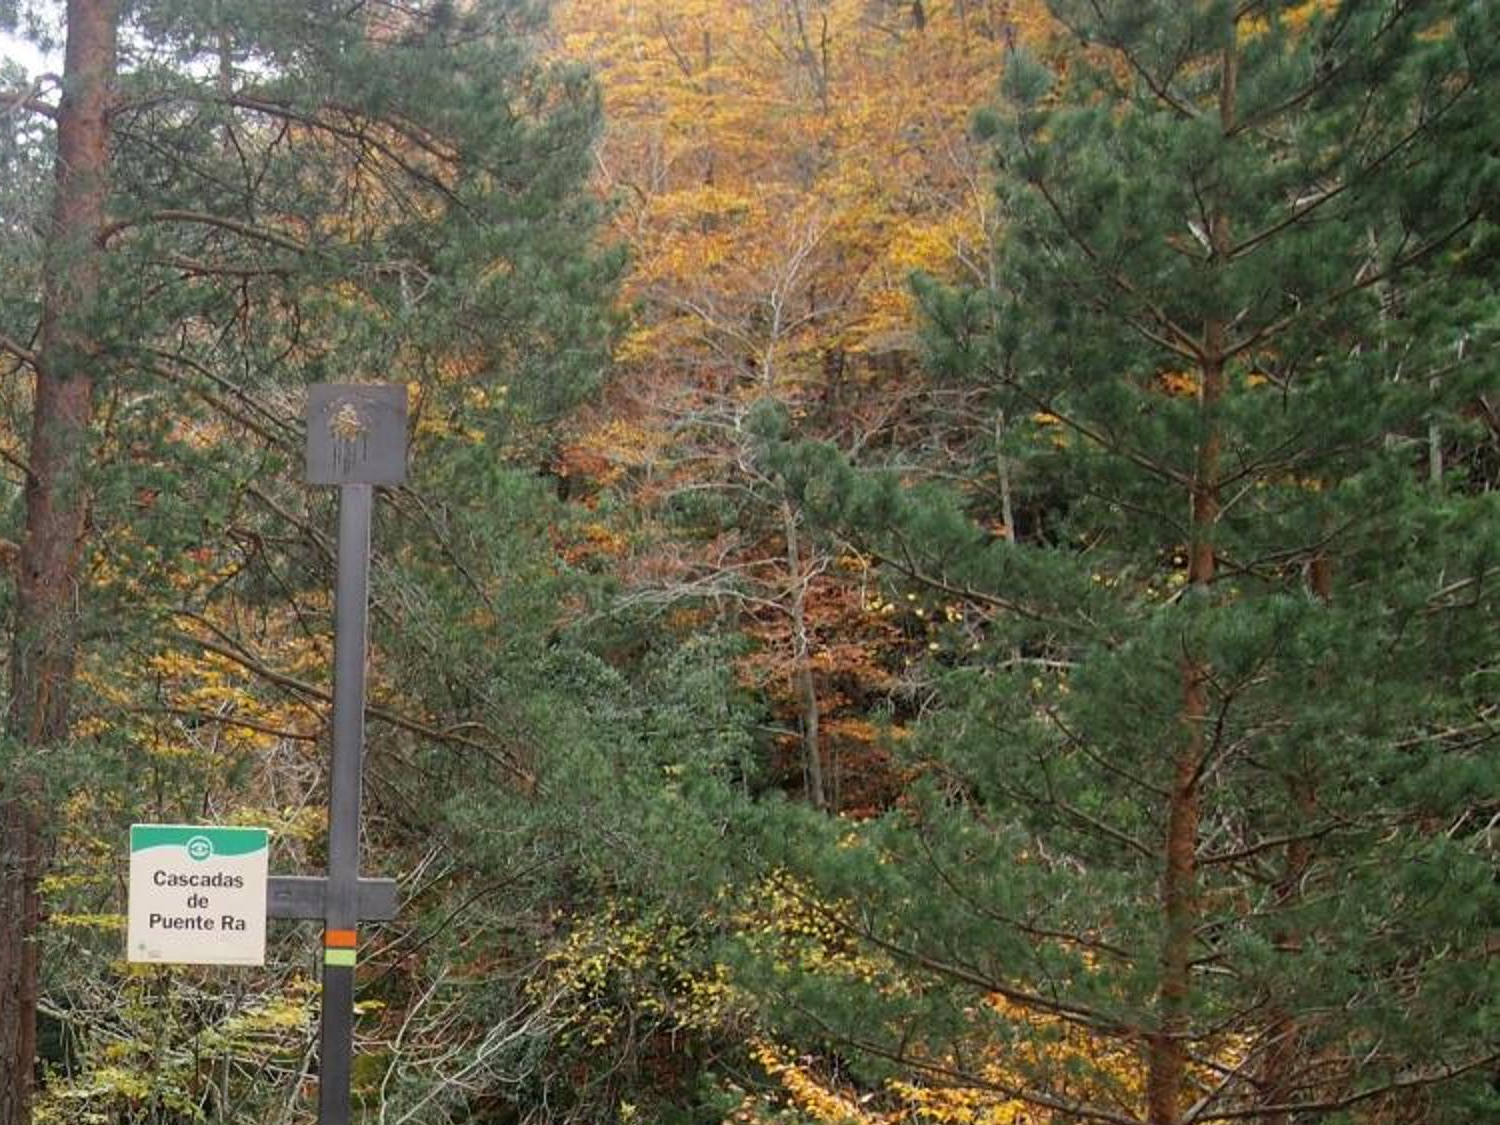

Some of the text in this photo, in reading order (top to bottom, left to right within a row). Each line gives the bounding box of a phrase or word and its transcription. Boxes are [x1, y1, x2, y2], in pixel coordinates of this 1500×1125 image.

[153, 870, 244, 888] Cascadas
[187, 893, 209, 909] de
[149, 914, 246, 931] Puente Ra
